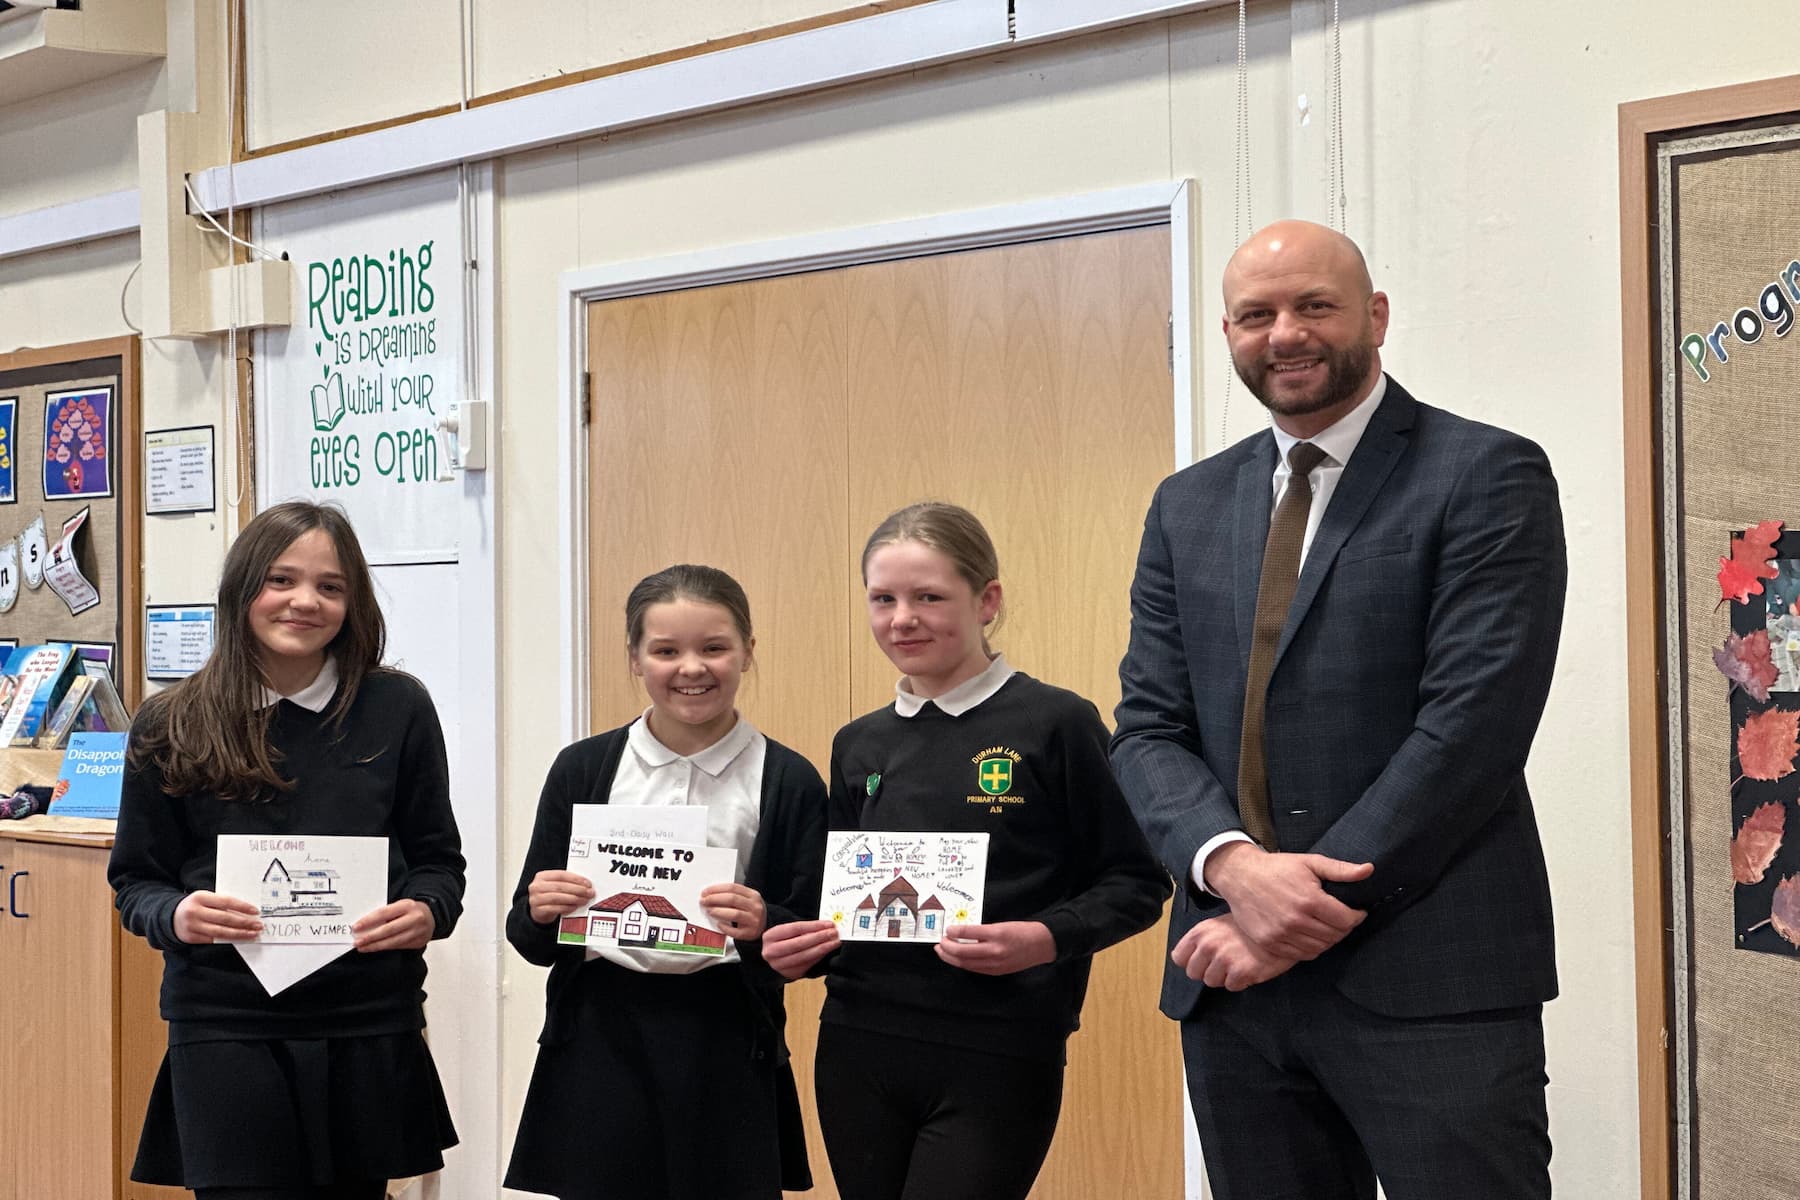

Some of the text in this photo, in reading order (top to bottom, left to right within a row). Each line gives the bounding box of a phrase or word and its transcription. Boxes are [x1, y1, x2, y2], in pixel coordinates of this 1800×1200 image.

[971, 746, 1022, 764] DURHAM LANE
[966, 795, 1025, 804] PRIMARY SCHOOL
[598, 843, 694, 863] WELCOME TO
[609, 859, 682, 881] YOUR NEW
[262, 923, 302, 936] AYLOR
